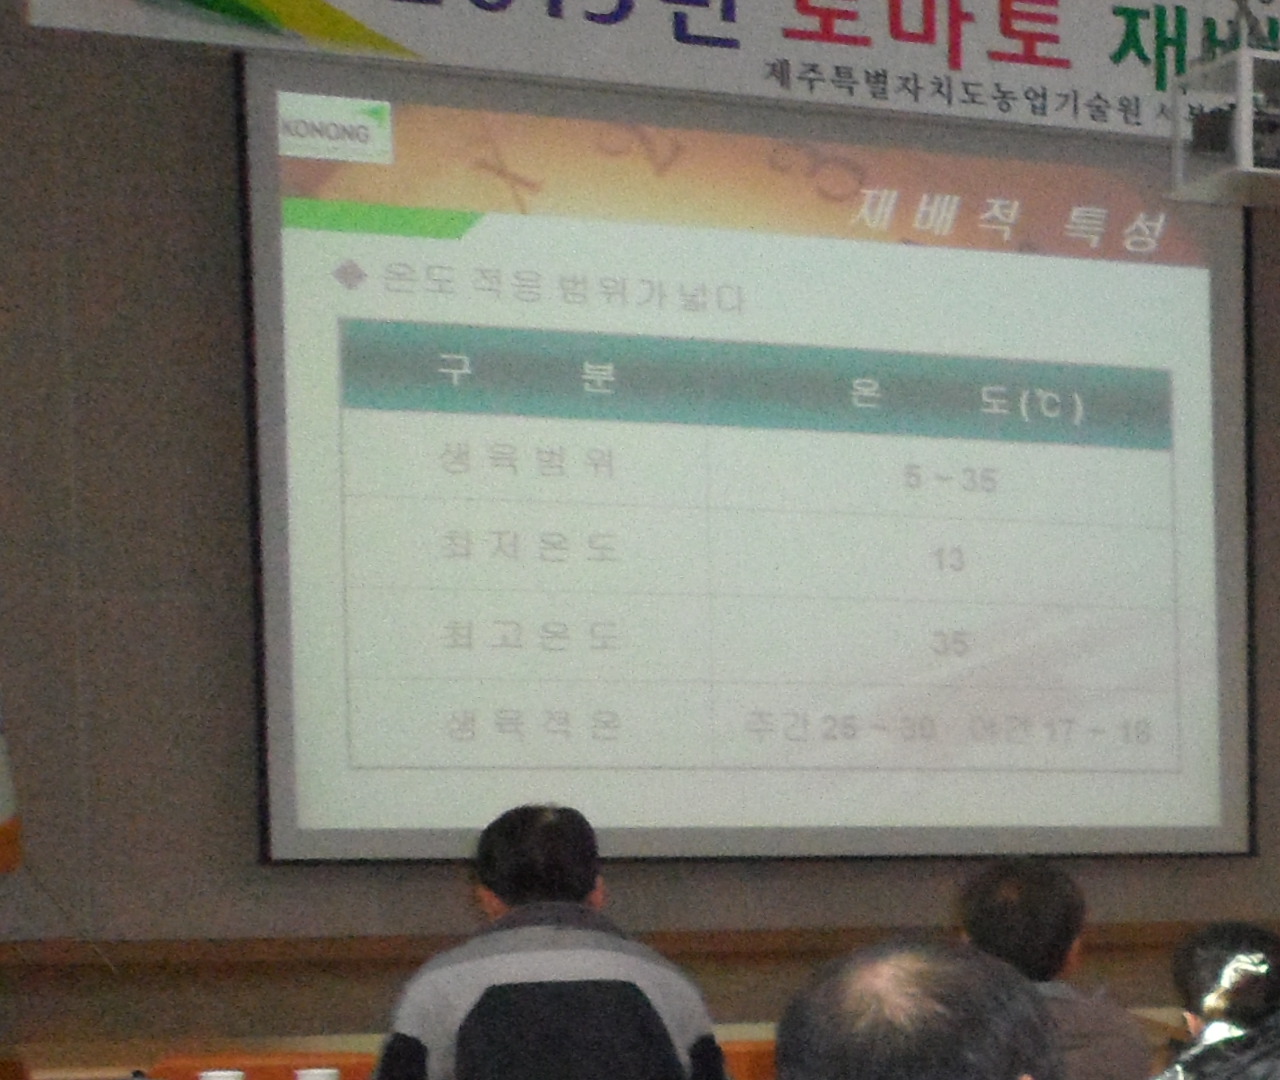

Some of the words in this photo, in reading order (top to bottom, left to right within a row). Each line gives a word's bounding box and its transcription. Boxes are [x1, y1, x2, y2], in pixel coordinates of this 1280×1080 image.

[782, 0, 1072, 70] 토마토
[1063, 204, 1167, 254] 특성
[382, 260, 457, 296] 온도
[930, 546, 966, 573] 13
[931, 629, 973, 658] 35
